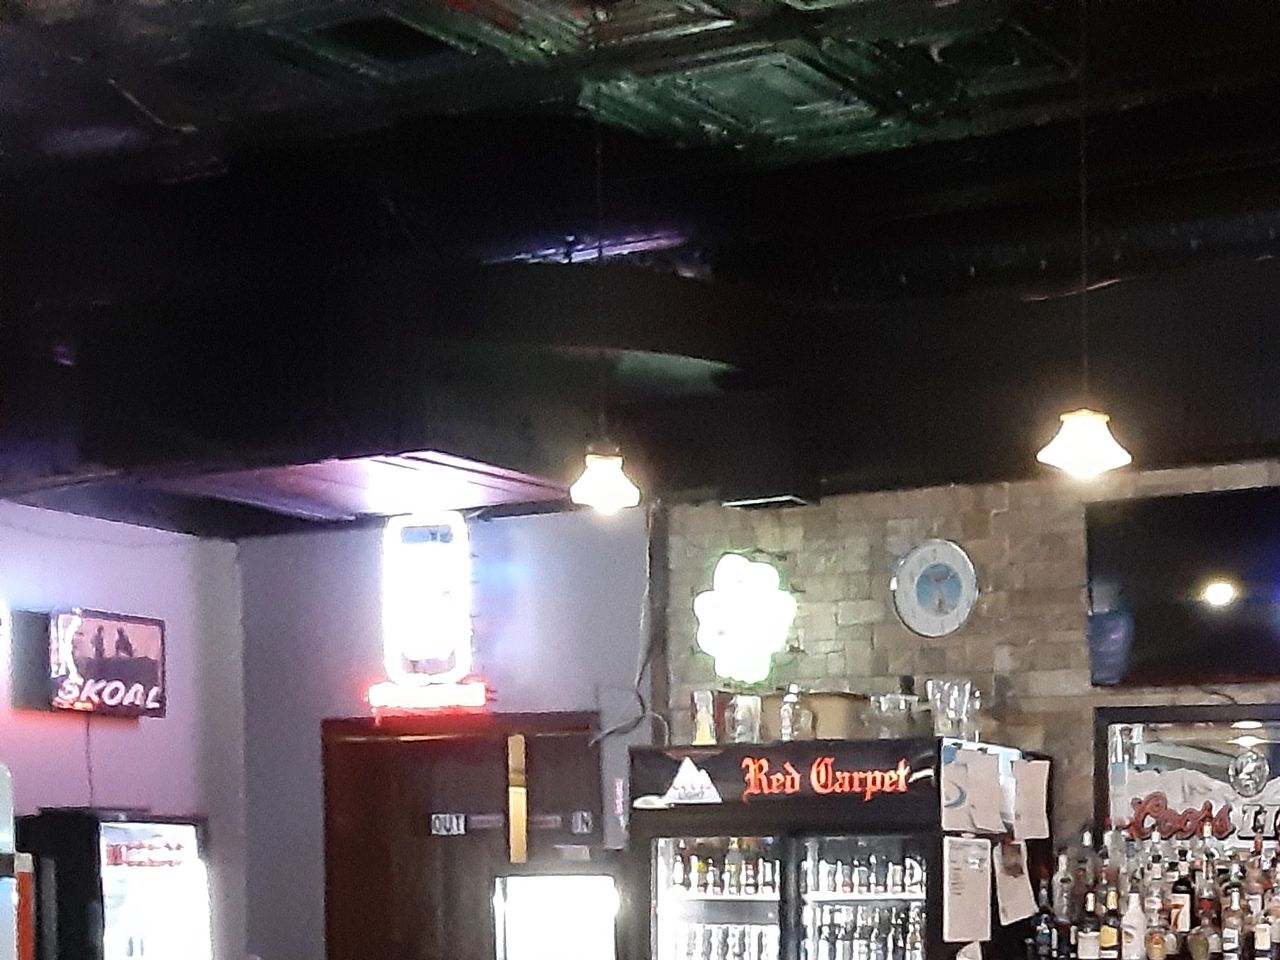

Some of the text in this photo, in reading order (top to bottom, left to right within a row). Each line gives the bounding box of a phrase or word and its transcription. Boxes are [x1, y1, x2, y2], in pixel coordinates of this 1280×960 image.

[57, 679, 160, 709] SKOAL
[741, 757, 911, 802] Red Carpet
[432, 814, 465, 834] OUT
[1125, 790, 1235, 840] Coors
